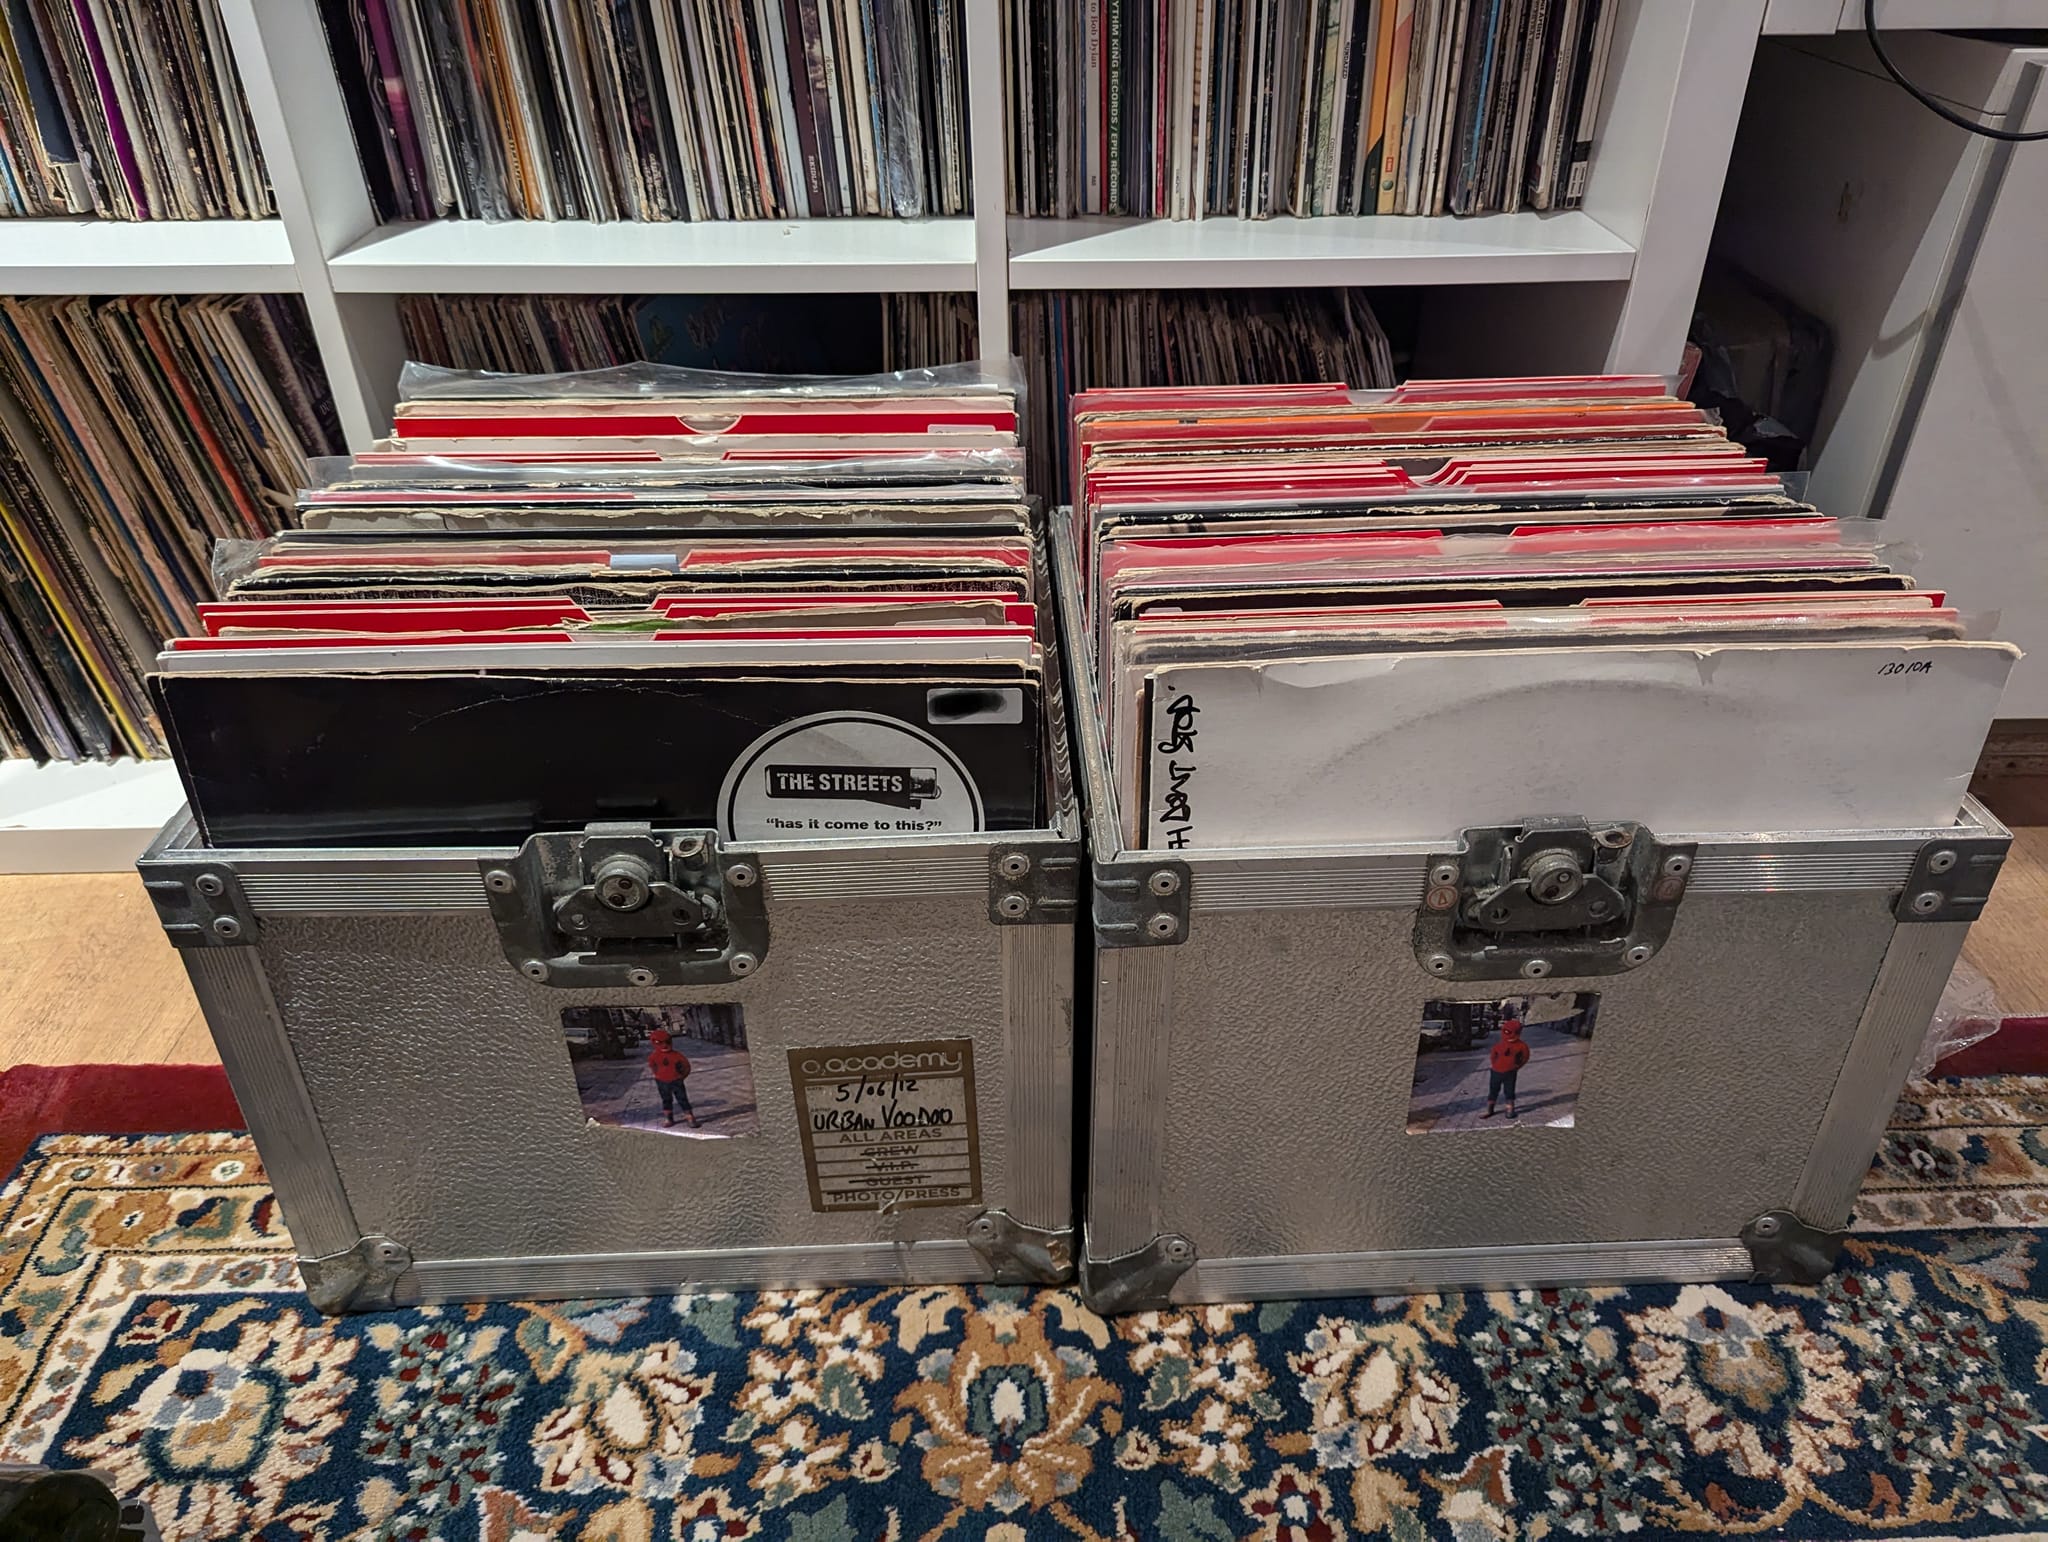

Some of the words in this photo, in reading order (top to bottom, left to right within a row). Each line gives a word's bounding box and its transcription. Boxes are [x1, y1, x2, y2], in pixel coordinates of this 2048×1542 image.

[1090, 2, 1097, 13] to
[1111, 0, 1120, 36] YTHM
[1090, 15, 1098, 36] Bob
[1089, 39, 1098, 69] Dylan
[1111, 38, 1120, 69] KING
[1110, 70, 1120, 124] RECORDS
[1110, 133, 1119, 157] EPIC
[1109, 158, 1119, 210] RECORDS
[776, 772, 815, 791] THE
[819, 772, 903, 793] STREETS
[808, 818, 820, 830] it
[824, 820, 869, 830] come
[874, 819, 890, 830] to
[835, 1073, 919, 1104] 5/06/12
[813, 1109, 875, 1130] URBAN
[881, 1099, 953, 1128] VOODOO
[839, 1132, 874, 1143] ALL
[880, 1128, 942, 1141] AREAS
[833, 1187, 961, 1203] PHOTO/PRESS
